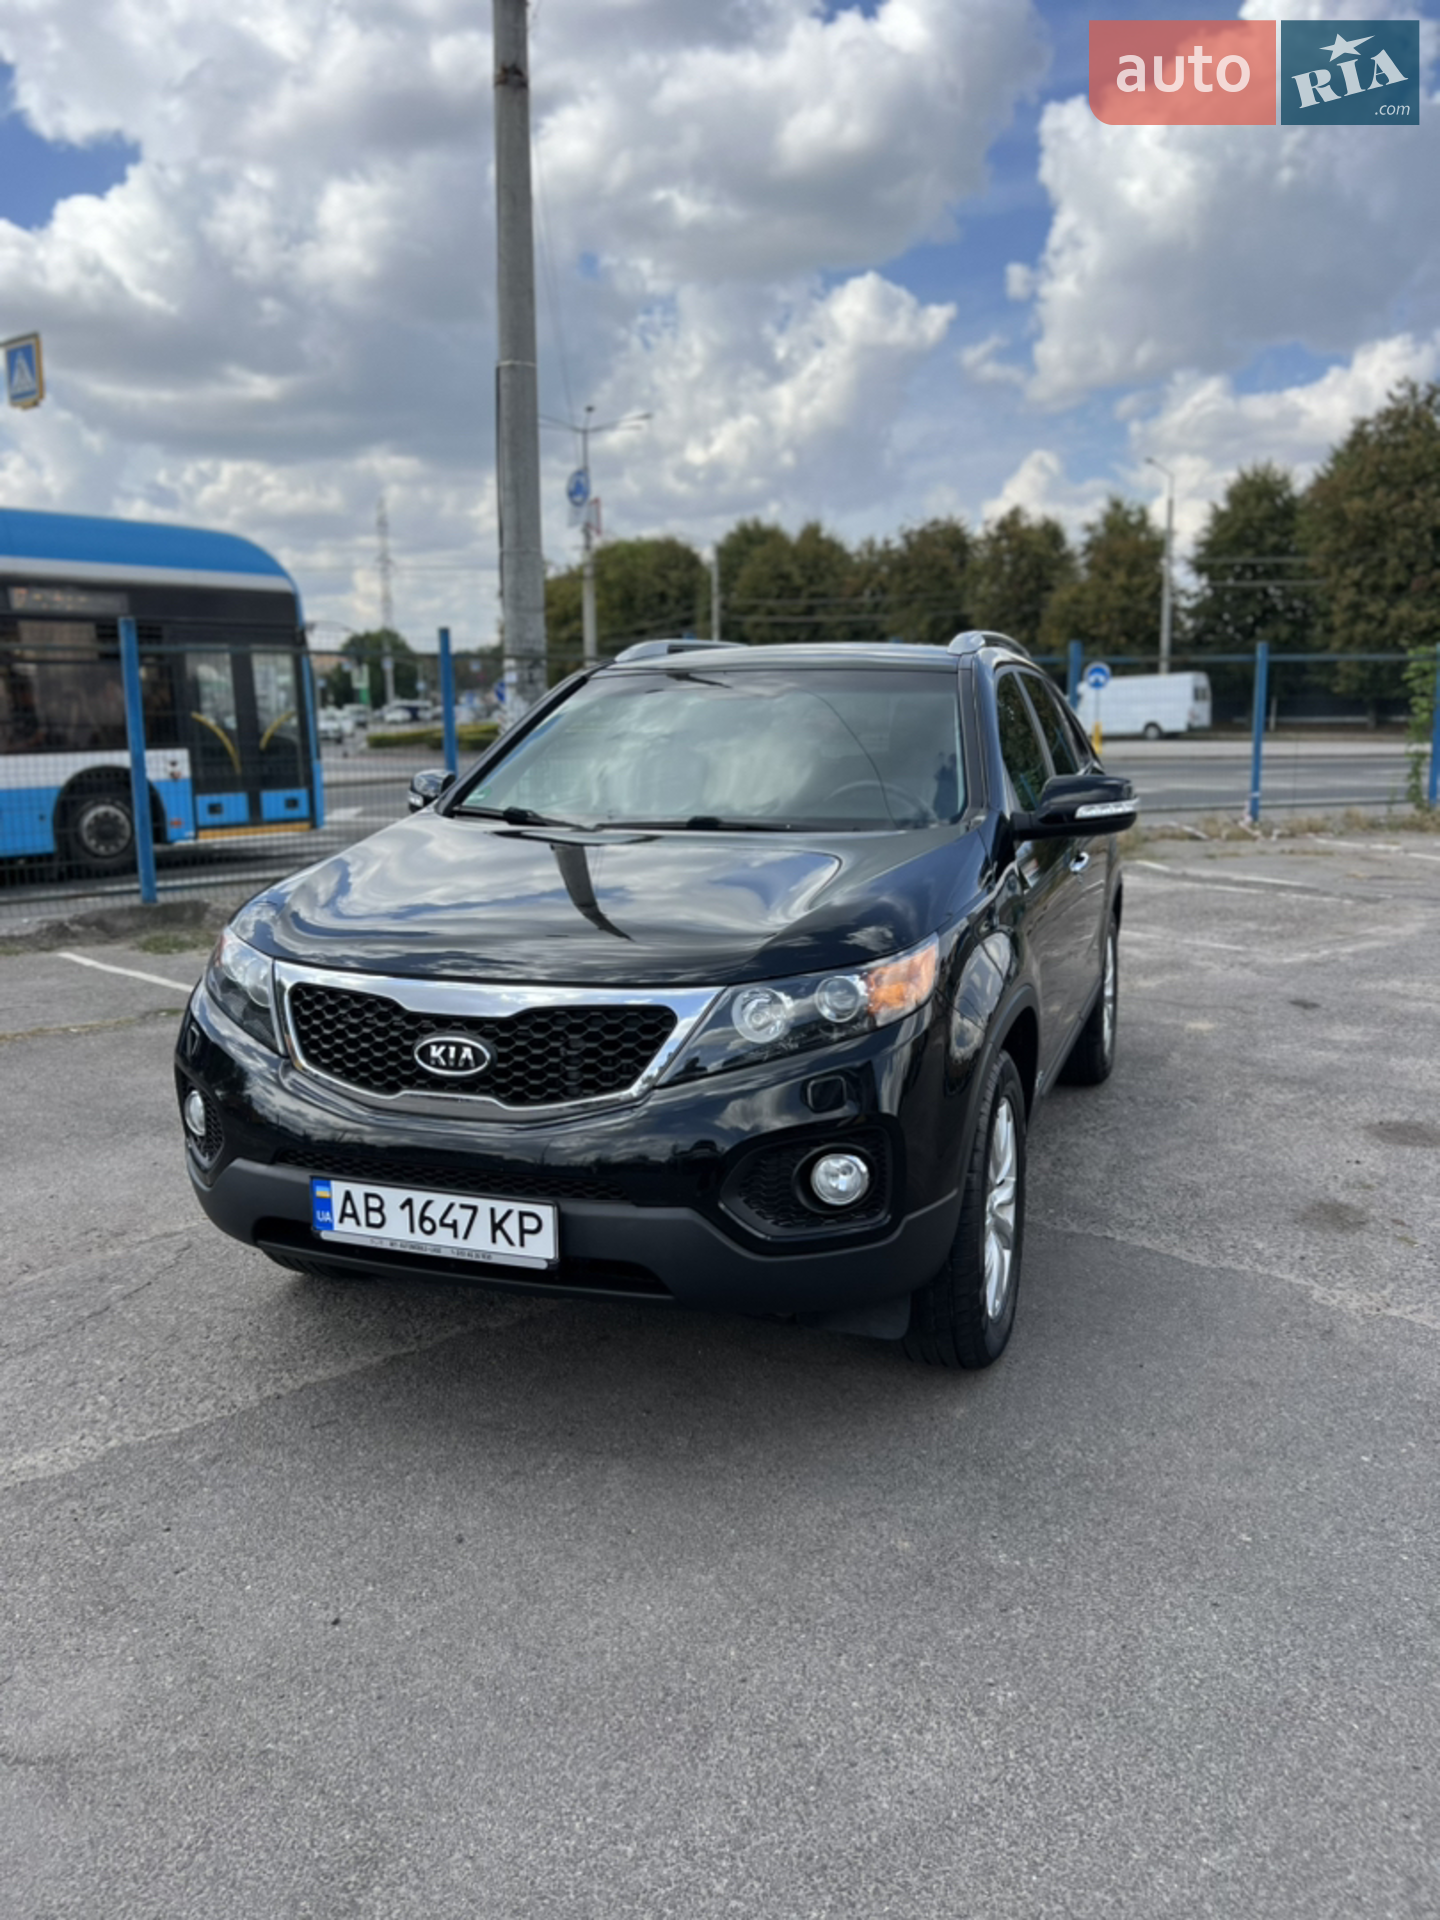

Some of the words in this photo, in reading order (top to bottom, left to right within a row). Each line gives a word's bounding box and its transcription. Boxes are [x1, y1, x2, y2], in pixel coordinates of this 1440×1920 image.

[429, 1044, 475, 1067] KIA
[316, 1209, 333, 1223] UA
[338, 1189, 387, 1229] AB
[399, 1197, 479, 1240] 1647
[489, 1207, 543, 1248] KP
